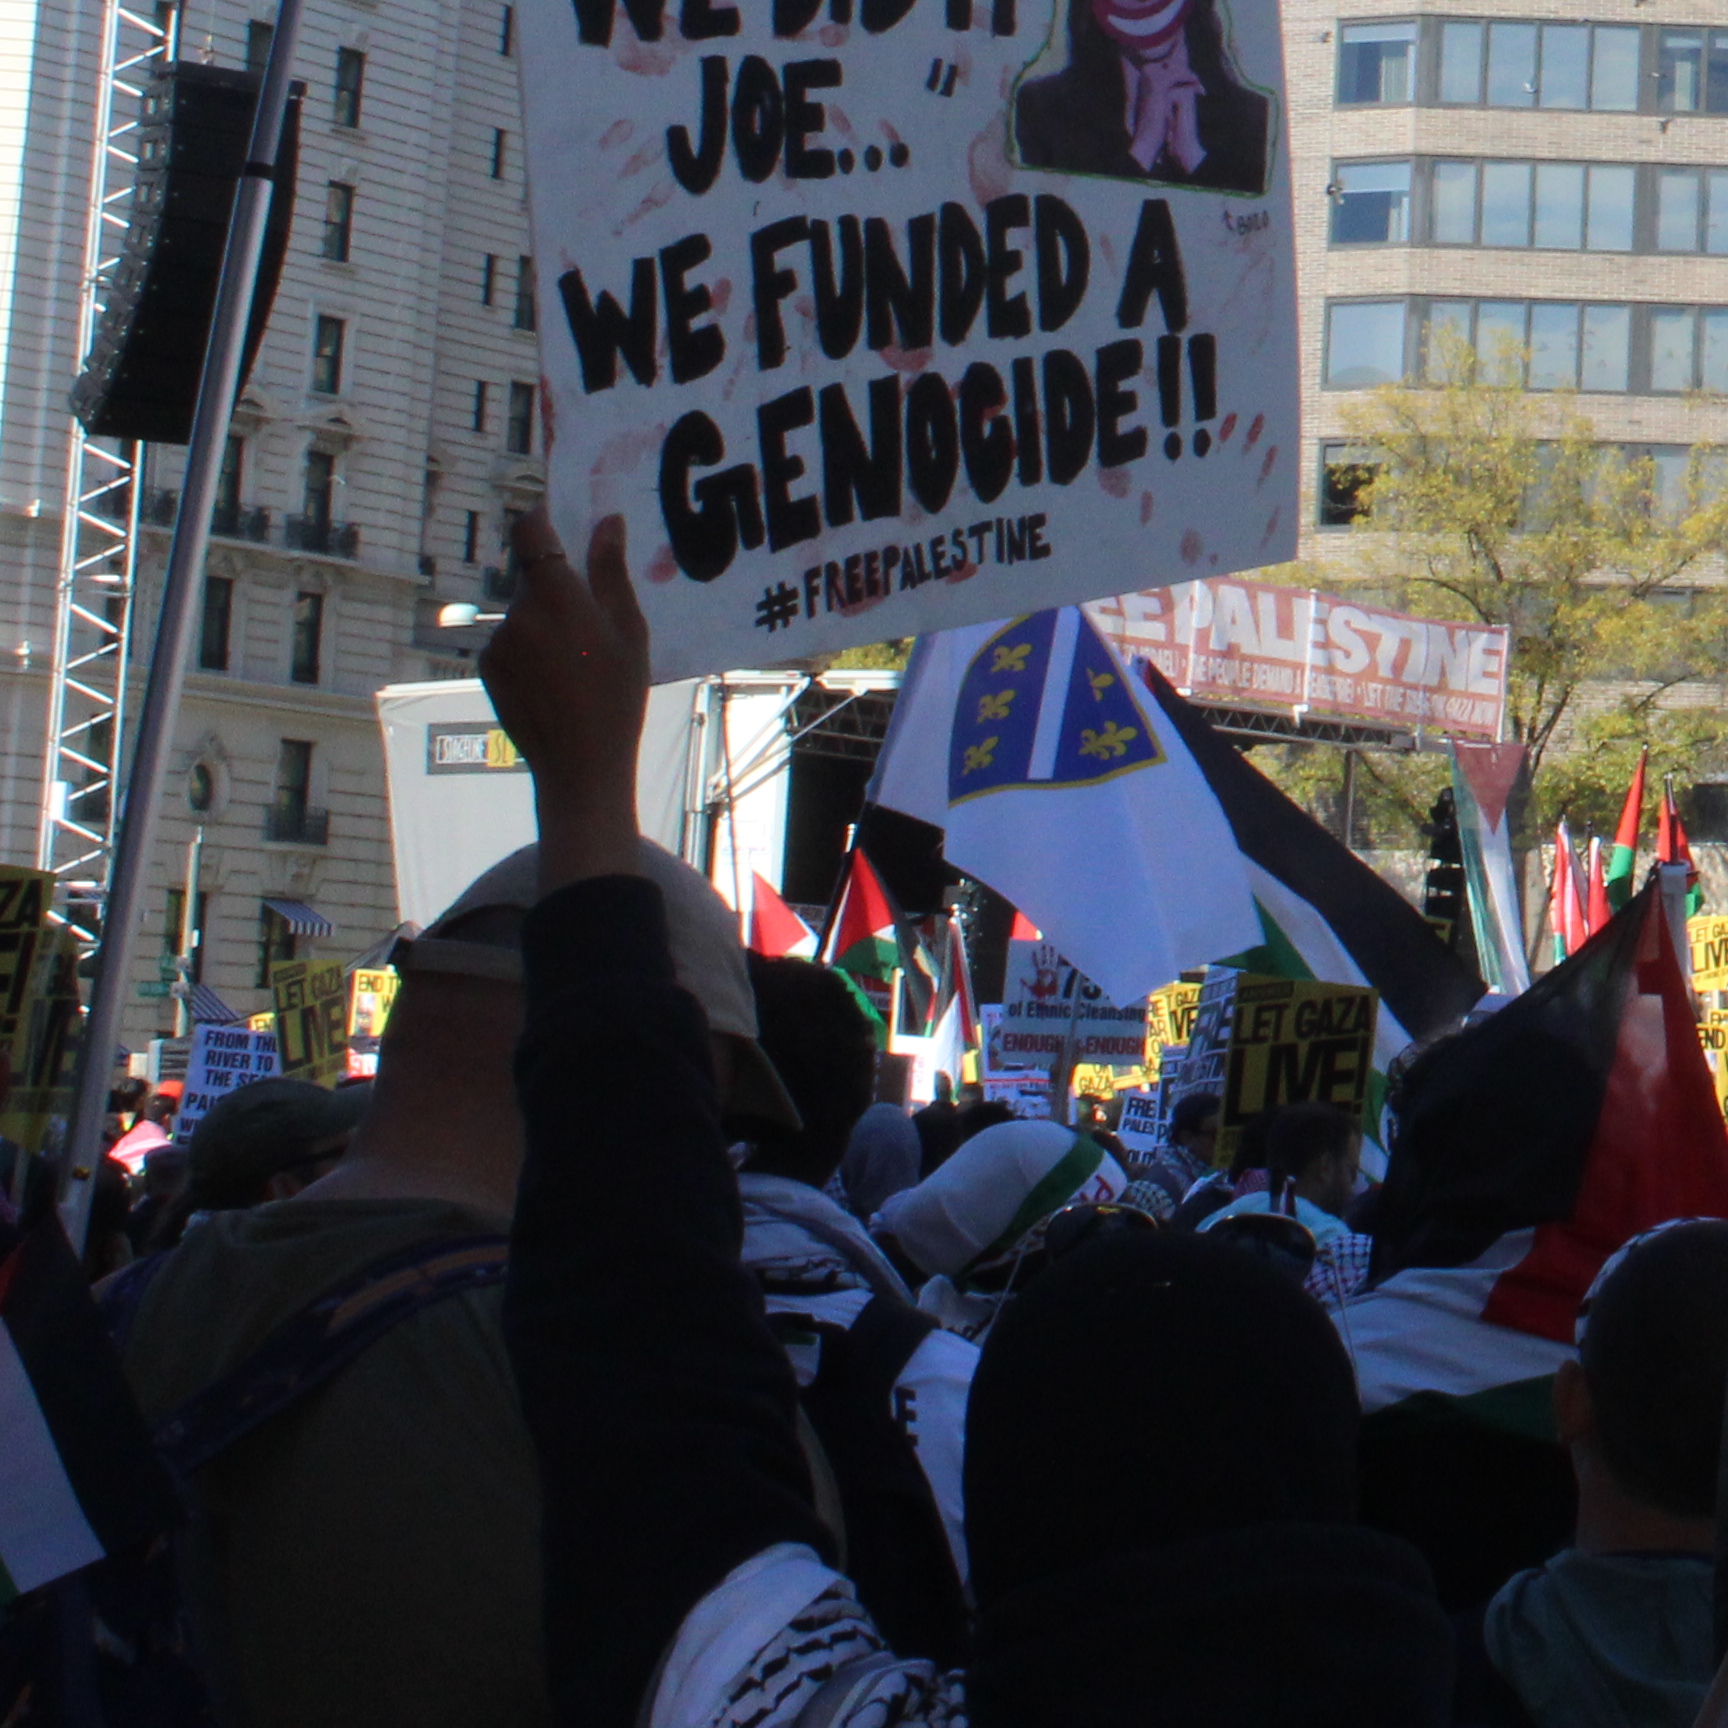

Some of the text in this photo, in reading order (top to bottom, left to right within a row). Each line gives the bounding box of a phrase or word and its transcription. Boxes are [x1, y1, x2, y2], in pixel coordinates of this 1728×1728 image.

[557, 192, 1188, 396] WE FUNDED A
[658, 333, 1219, 583] GENOCIDE!!
[754, 512, 1052, 633] #FREEPALESTINE
[1170, 581, 1503, 696] PALESTINE
[1689, 927, 1708, 944] LET
[276, 979, 305, 1011] LET
[1009, 1003, 1022, 1019] of
[1027, 1003, 1072, 1022] Ethnic
[1232, 1004, 1289, 1044] LET
[1294, 994, 1371, 1041] GAZA
[204, 1031, 249, 1049] FROM
[1003, 1033, 1065, 1054] ENOUGH
[1697, 1027, 1727, 1050] END
[205, 1050, 274, 1070] RIVER TO
[205, 1069, 232, 1087] THE
[1078, 1076, 1112, 1094] GAZA
[1224, 1035, 1370, 1127] LIVE!
